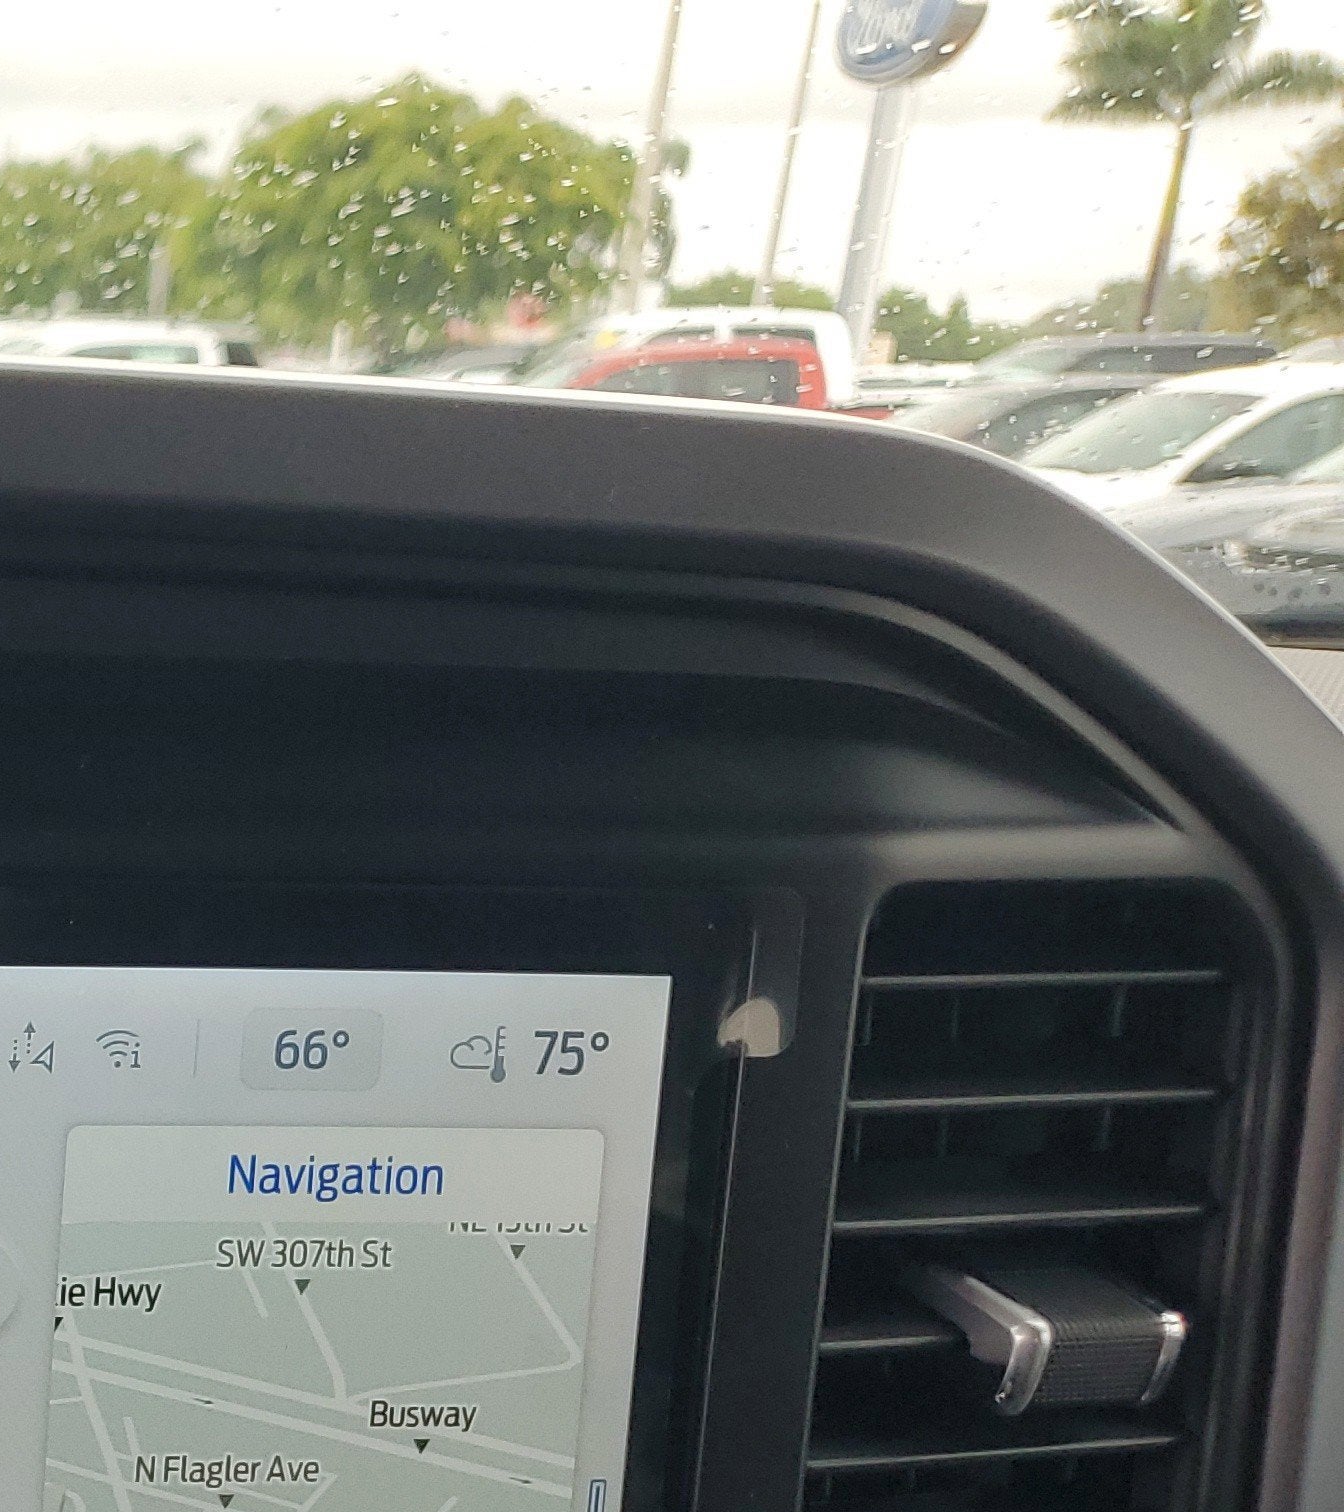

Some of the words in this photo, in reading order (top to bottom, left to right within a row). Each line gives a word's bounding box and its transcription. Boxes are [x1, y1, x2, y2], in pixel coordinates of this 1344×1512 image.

[273, 1028, 351, 1071] 66°
[534, 1030, 610, 1076] 75°
[227, 1154, 444, 1202] Navigation
[216, 1239, 266, 1268] SW
[270, 1238, 355, 1268] 307th
[360, 1239, 393, 1268] St
[55, 1276, 86, 1307] ie
[93, 1276, 163, 1312] Hwy
[369, 1400, 477, 1434] Busway
[135, 1455, 157, 1484] N
[162, 1454, 261, 1488] Flagler
[266, 1455, 320, 1483] Ave
